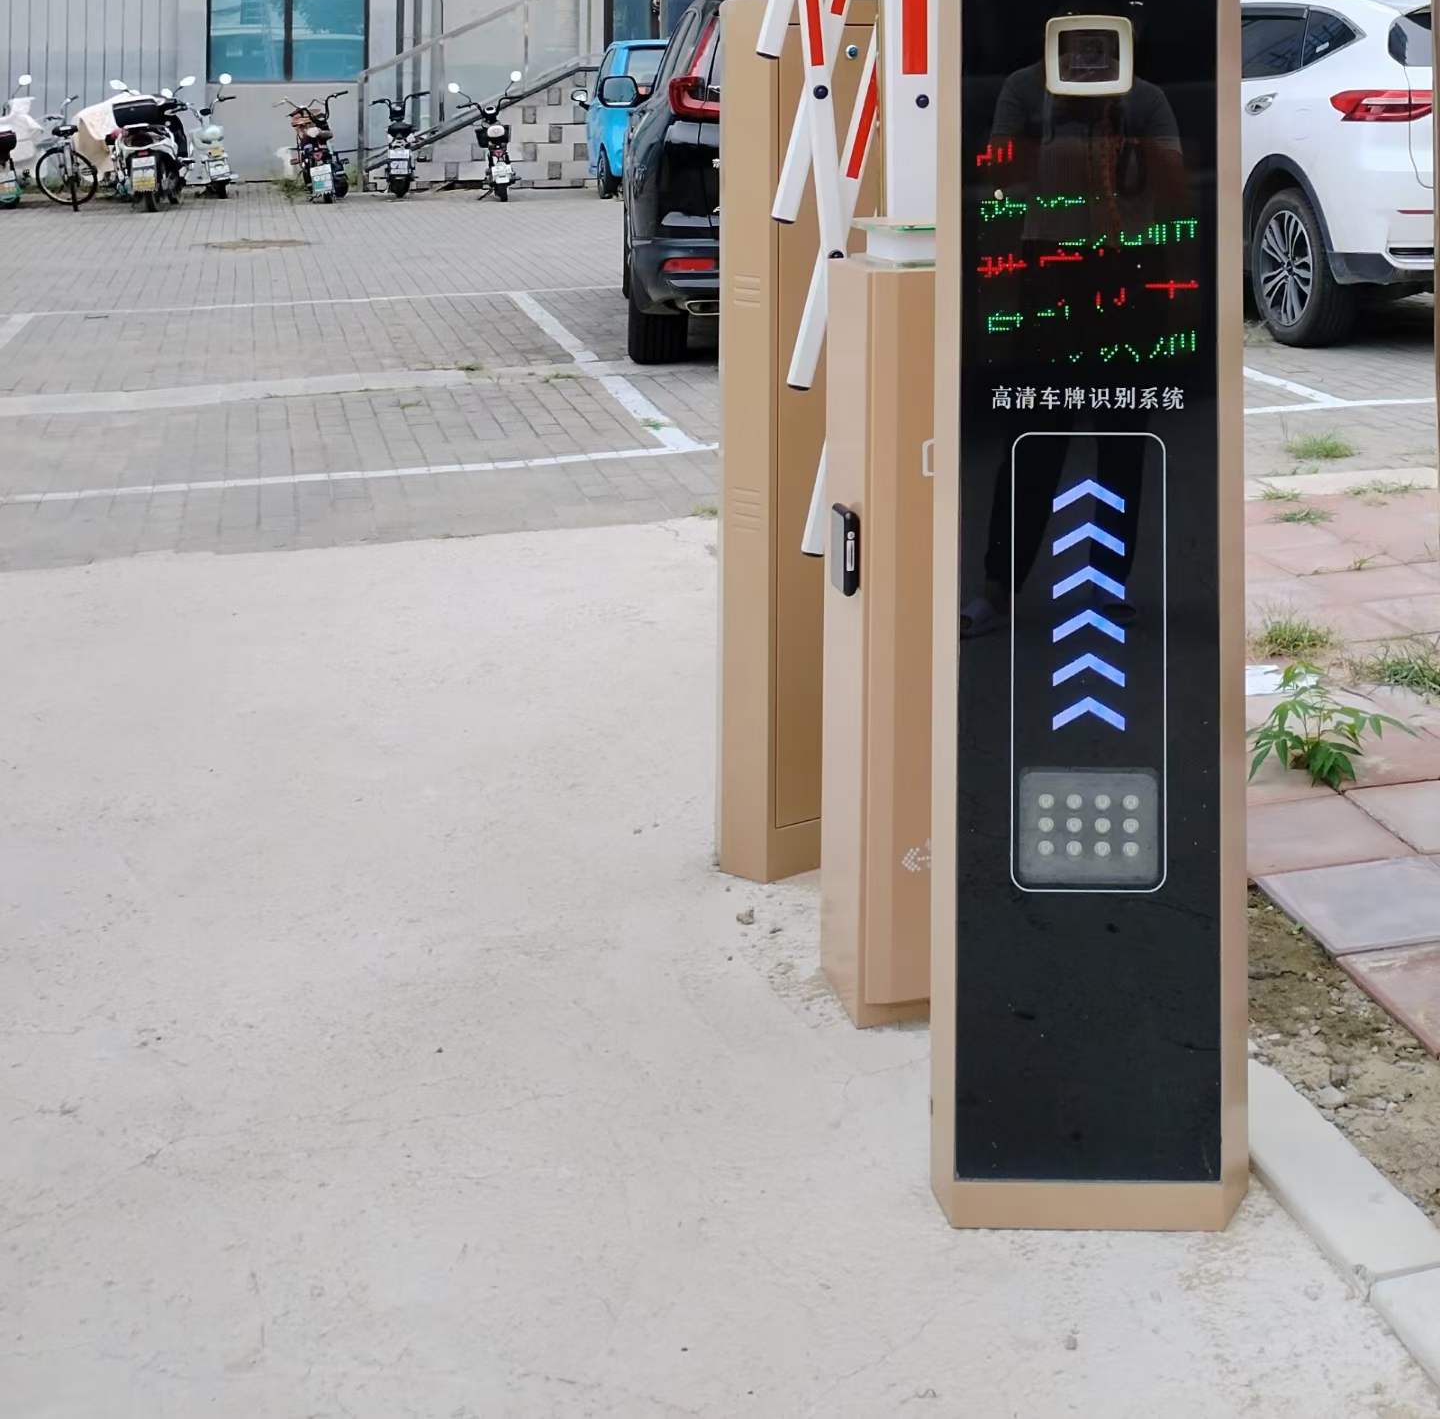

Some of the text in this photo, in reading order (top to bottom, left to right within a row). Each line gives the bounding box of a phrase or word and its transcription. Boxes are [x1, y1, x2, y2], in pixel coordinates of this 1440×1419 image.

[991, 385, 1185, 410] 高清车牌识别系统
